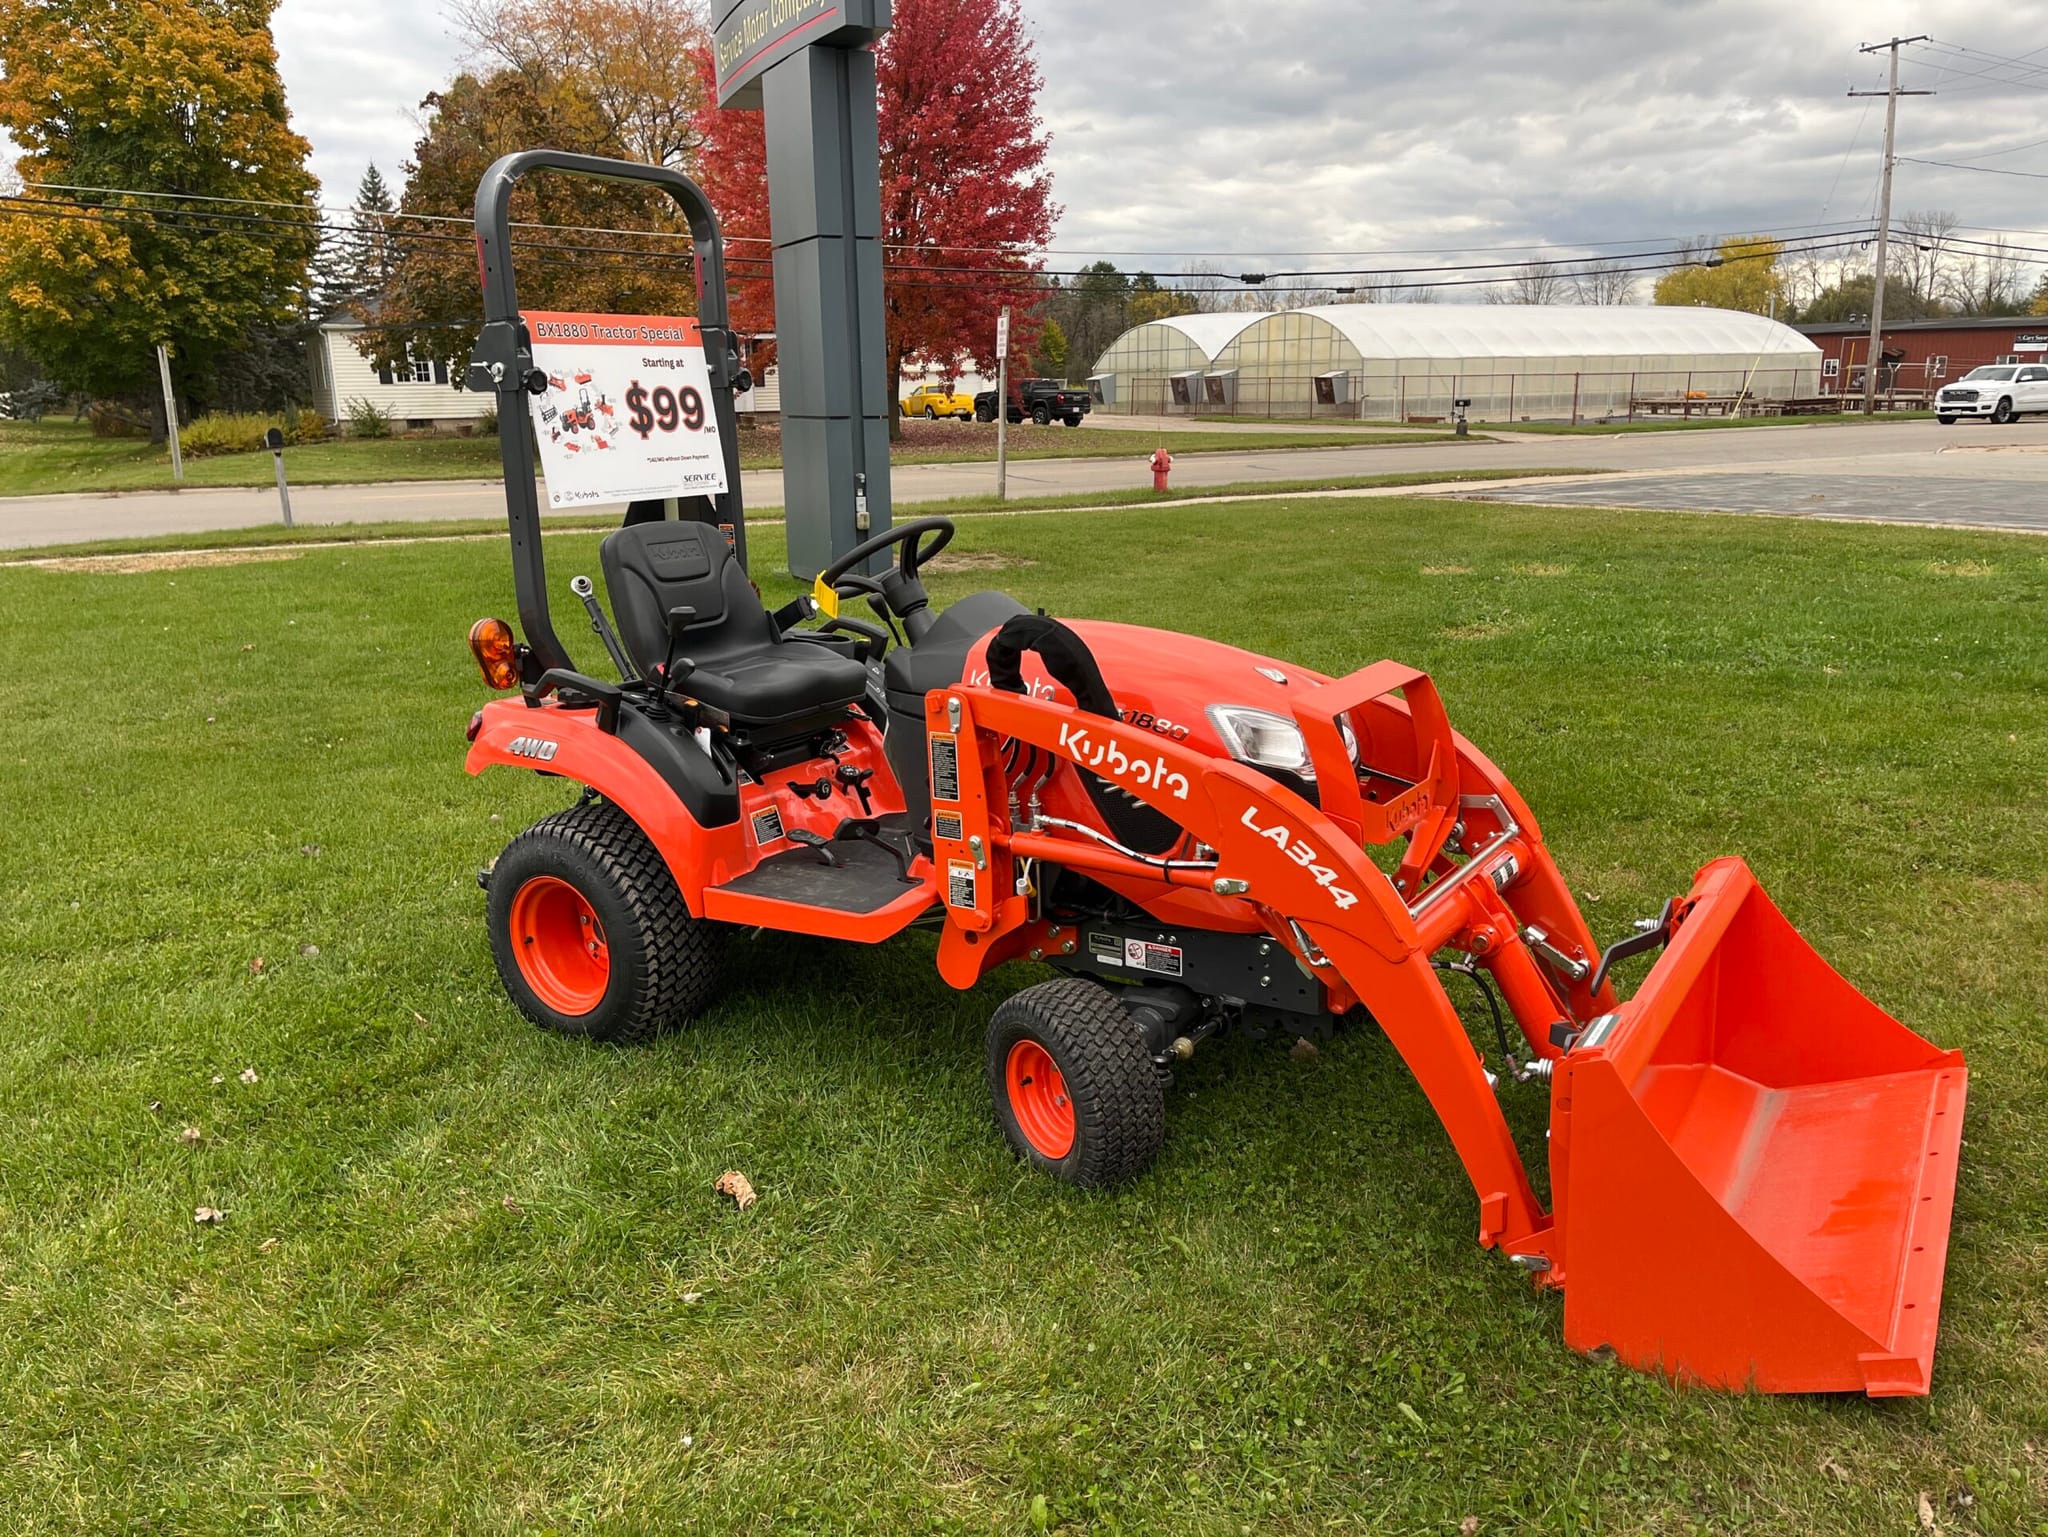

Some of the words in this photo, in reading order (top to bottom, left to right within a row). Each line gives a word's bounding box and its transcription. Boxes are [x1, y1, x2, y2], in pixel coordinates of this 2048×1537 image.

[719, 31, 743, 73] Service
[743, 8, 769, 49] Motor
[770, 0, 825, 28] Comp
[536, 322, 589, 338] BX1880
[591, 324, 638, 340] Tractor
[640, 326, 684, 342] Special
[642, 357, 675, 370] Starting
[675, 359, 684, 368] at
[625, 379, 705, 441] $99
[684, 473, 716, 482] SERVICE
[508, 736, 559, 761] 4WD
[1058, 721, 1190, 801] Kubota
[1385, 792, 1430, 832] Kubota
[1240, 805, 1360, 911] LA344
